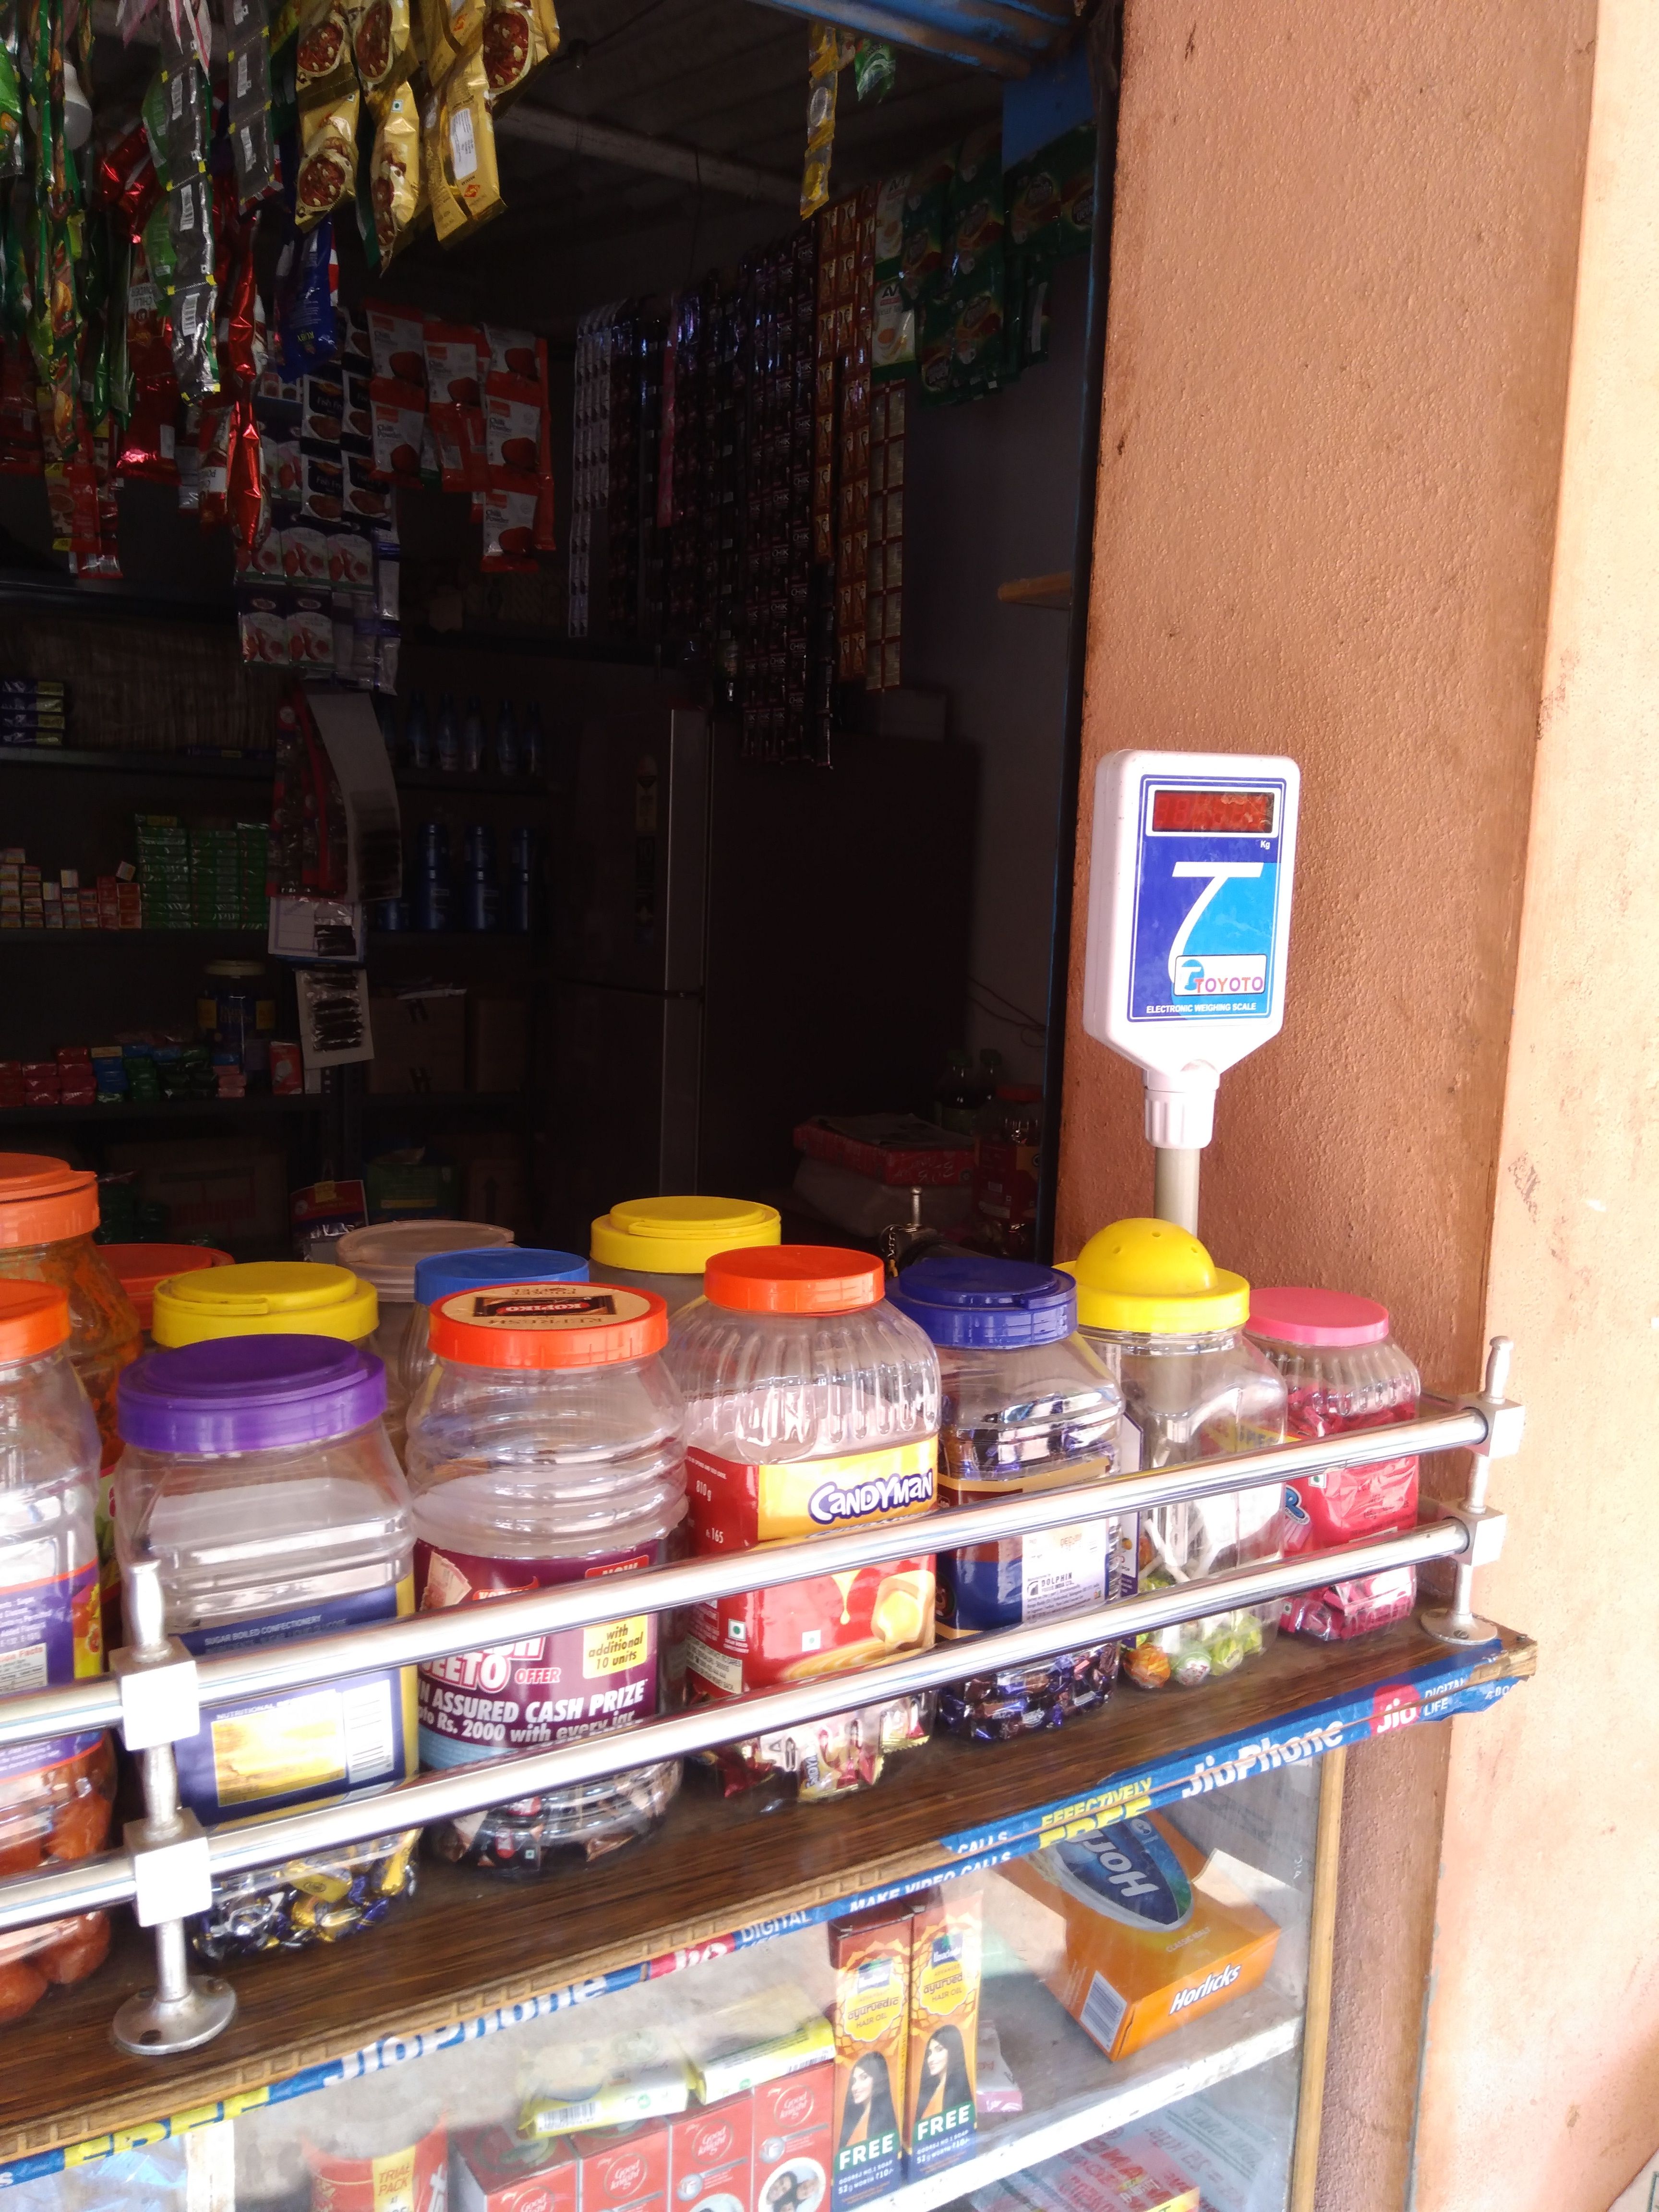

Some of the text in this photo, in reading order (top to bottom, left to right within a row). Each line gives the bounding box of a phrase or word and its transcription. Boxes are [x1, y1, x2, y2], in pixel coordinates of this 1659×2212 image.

[1260, 841, 1271, 850] Kg
[1195, 976, 1263, 993] TOYOTO
[1232, 1003, 1257, 1011] SCALE
[505, 1302, 582, 1311] KOPIKO
[1041, 1572, 1072, 1587] DOLPHIN
[606, 1623, 628, 1640] with
[589, 1631, 644, 1658] additional
[597, 1650, 637, 1670] 10 units
[515, 1667, 561, 1684] OFFER
[433, 1688, 519, 1723] ASSURED
[525, 1697, 584, 1723] CASH
[437, 1712, 458, 1734] Rs.
[461, 1719, 505, 1741] 2000
[510, 1723, 552, 1743] with
[1181, 1697, 1449, 1800] JioPhone Jio LIFE
[1041, 1777, 1152, 1827] EFFECTIVELY
[849, 1887, 900, 1913] MAKE
[905, 1870, 956, 1893] VIDEO
[740, 1911, 812, 1943] DIGITAL
[923, 1971, 965, 1995] ayurved
[932, 1987, 962, 2002] HAIR OIL
[1168, 1963, 1242, 2016] Horlicks
[847, 1996, 900, 2020] ayurvedic
[856, 2012, 888, 2029] HAIR OIL
[917, 2105, 971, 2141] FREE
[839, 2133, 895, 2171] FREE
